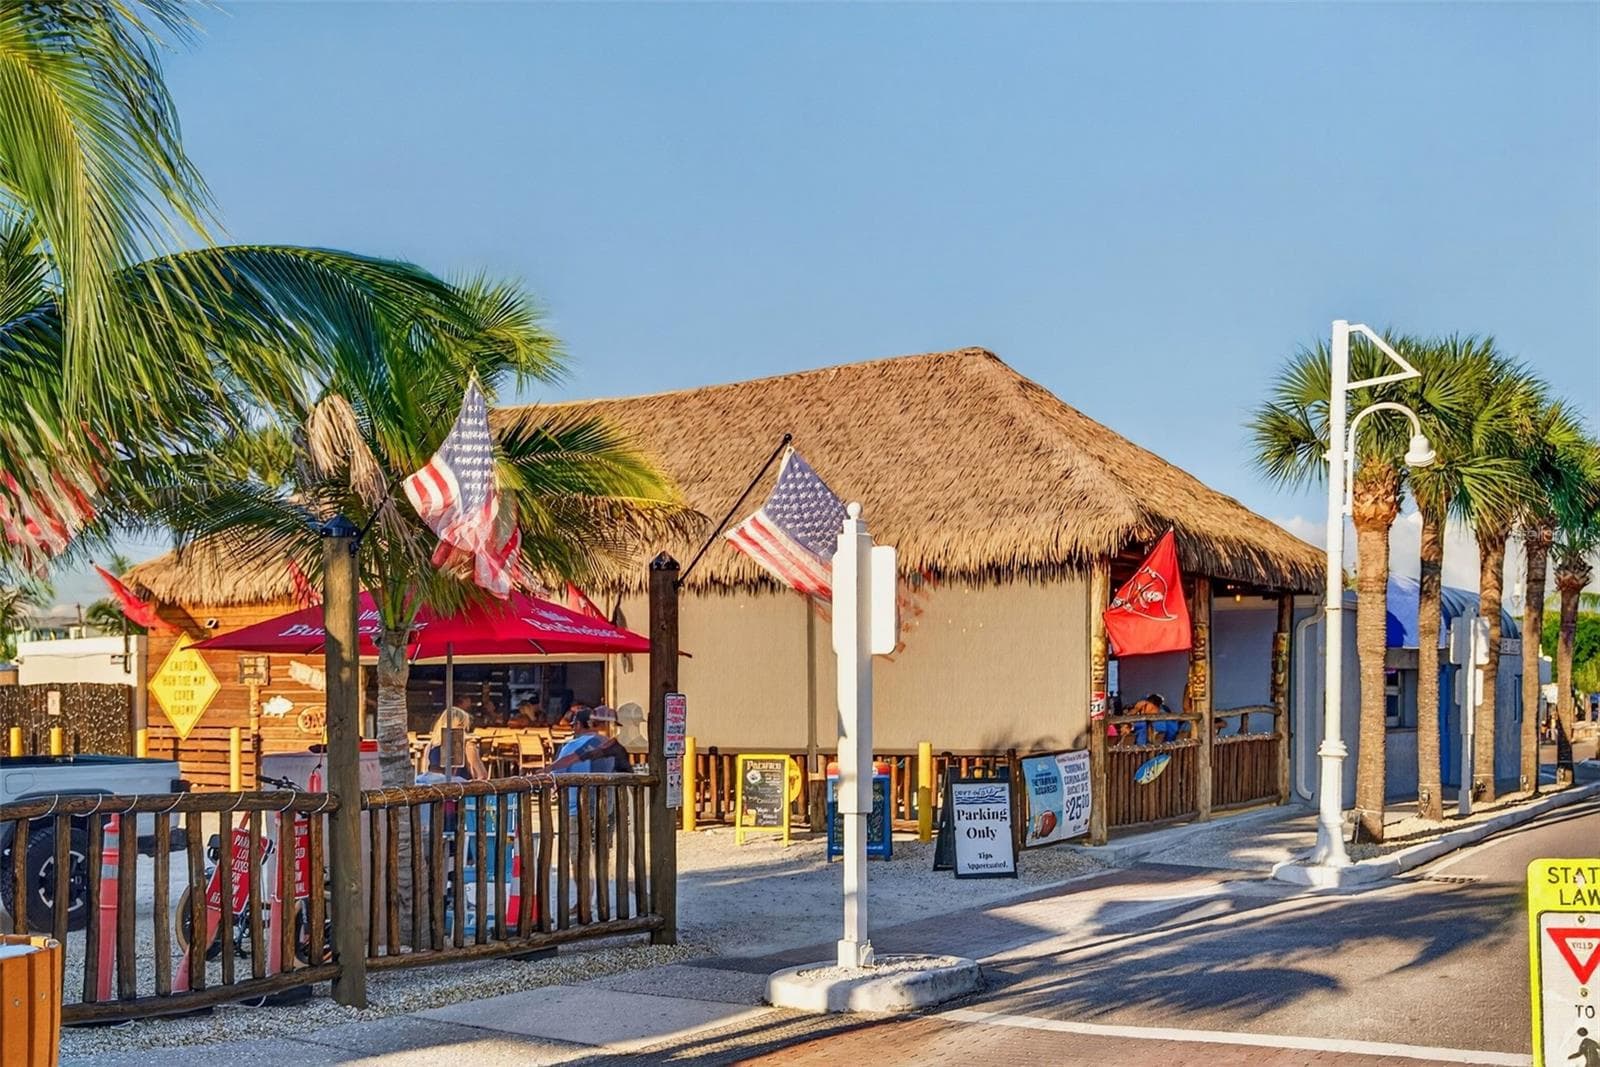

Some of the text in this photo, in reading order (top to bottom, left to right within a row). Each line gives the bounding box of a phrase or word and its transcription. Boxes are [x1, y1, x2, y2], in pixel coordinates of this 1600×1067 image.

[956, 807, 1008, 822] Parking
[966, 826, 997, 840] Only
[978, 851, 993, 860] Tips
[1547, 867, 1600, 884] STAT
[1559, 889, 1600, 906] LAW
[1574, 1004, 1596, 1019] TO
